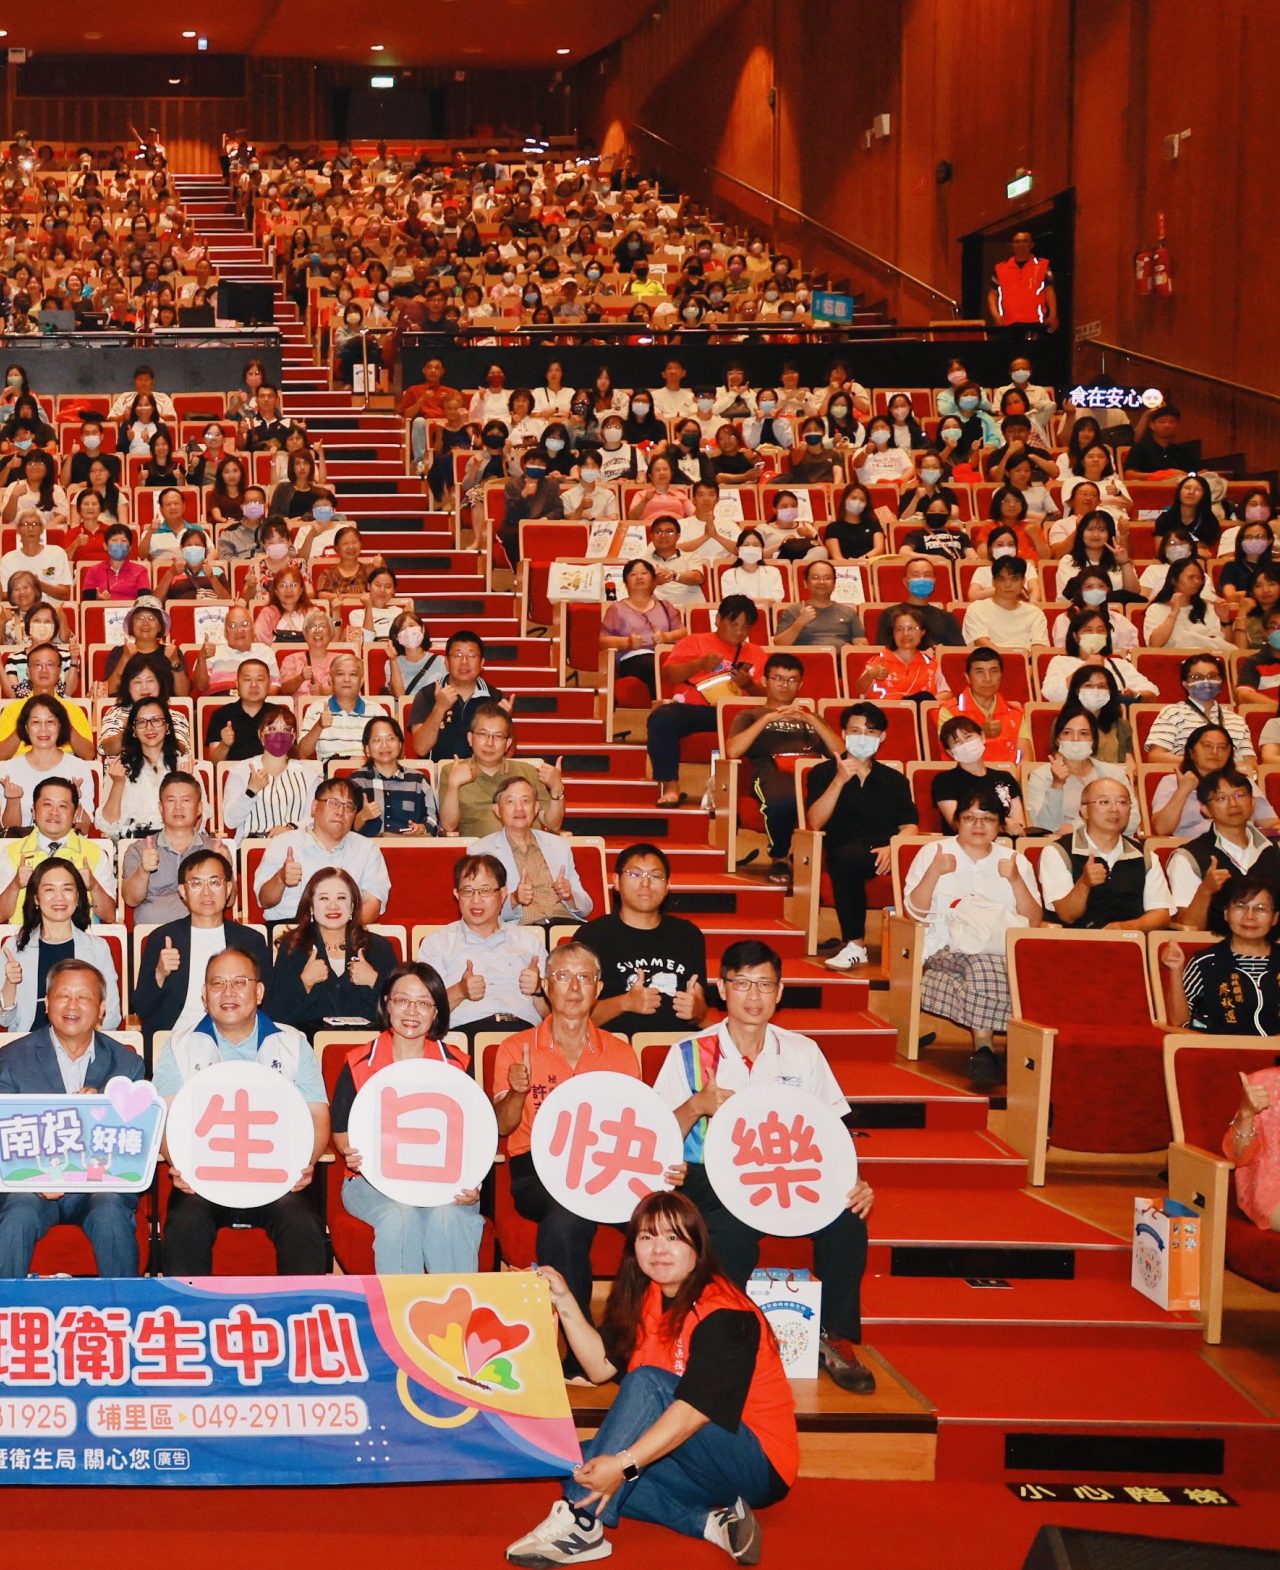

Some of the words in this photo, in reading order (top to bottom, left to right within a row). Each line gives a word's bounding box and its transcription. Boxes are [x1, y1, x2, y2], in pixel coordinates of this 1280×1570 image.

[1069, 385, 1141, 408] 食在安心
[616, 958, 686, 975] SUMMER
[92, 1125, 144, 1155] 好棒
[195, 1088, 288, 1184] 生
[381, 1086, 464, 1184] 日
[549, 1102, 663, 1200] 快
[731, 1110, 823, 1208] 樂
[97, 1404, 174, 1431] 埔里區
[191, 1403, 360, 1430] 049-2911925
[83, 1447, 151, 1470] 關心您
[157, 1451, 187, 1467] 廣告
[1020, 1483, 1229, 1504] 小心階梯
